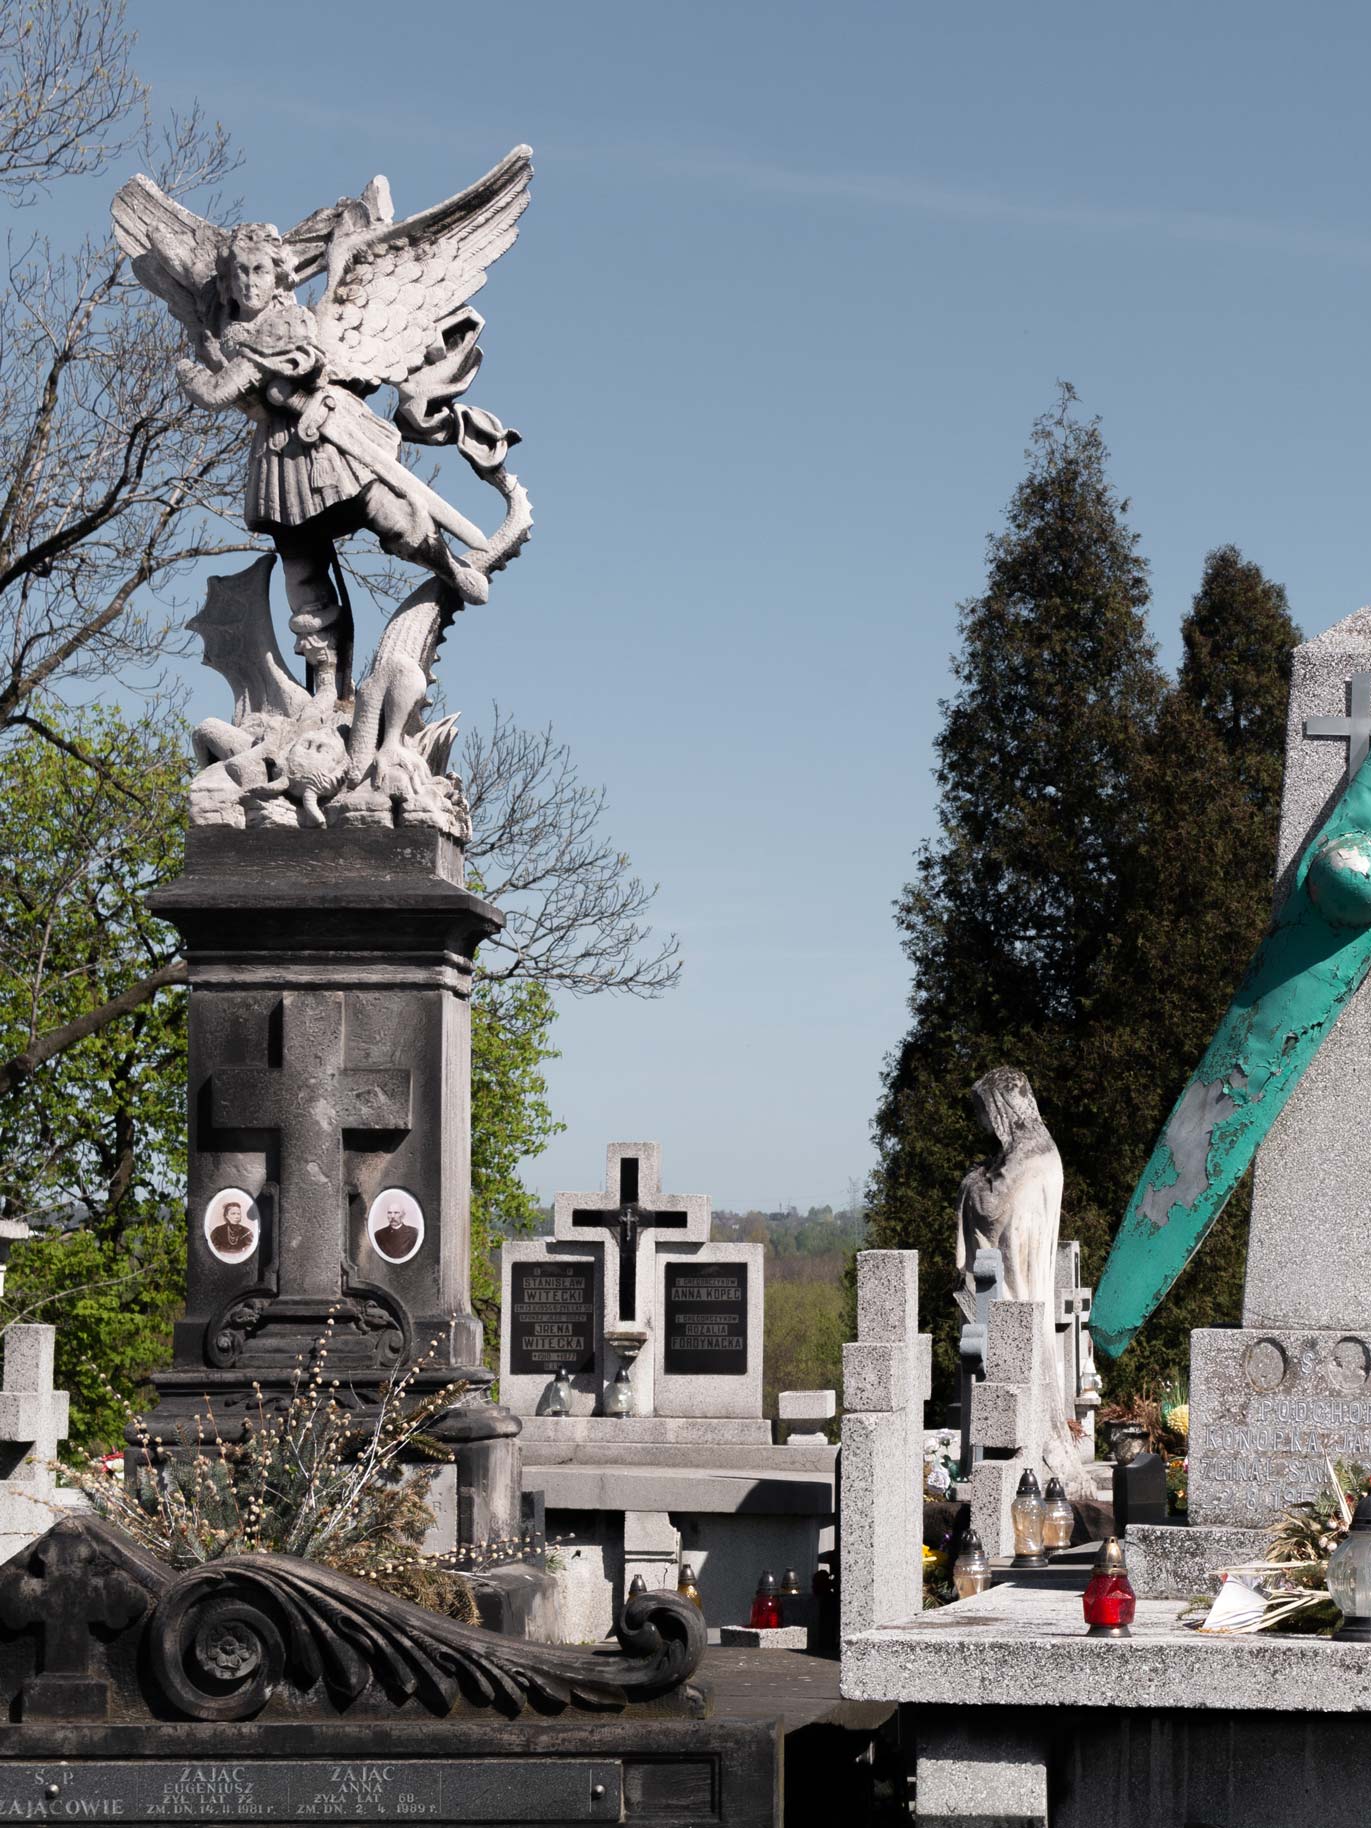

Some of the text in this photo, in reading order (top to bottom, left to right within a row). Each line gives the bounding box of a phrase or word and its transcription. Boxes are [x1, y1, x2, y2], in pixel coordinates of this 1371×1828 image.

[526, 1290, 582, 1302] WITECKI
[673, 1288, 702, 1300] ANNA
[524, 1337, 582, 1349] WITECKA
[1206, 1427, 1319, 1451] KONOPKA
[163, 1782, 255, 1794] EUGENIUSZ
[338, 1781, 384, 1793] ANNA
[200, 1794, 226, 1805] LAT
[237, 1794, 254, 1805] 72
[357, 1793, 382, 1804] LAT
[396, 1803, 426, 1815] 1989
